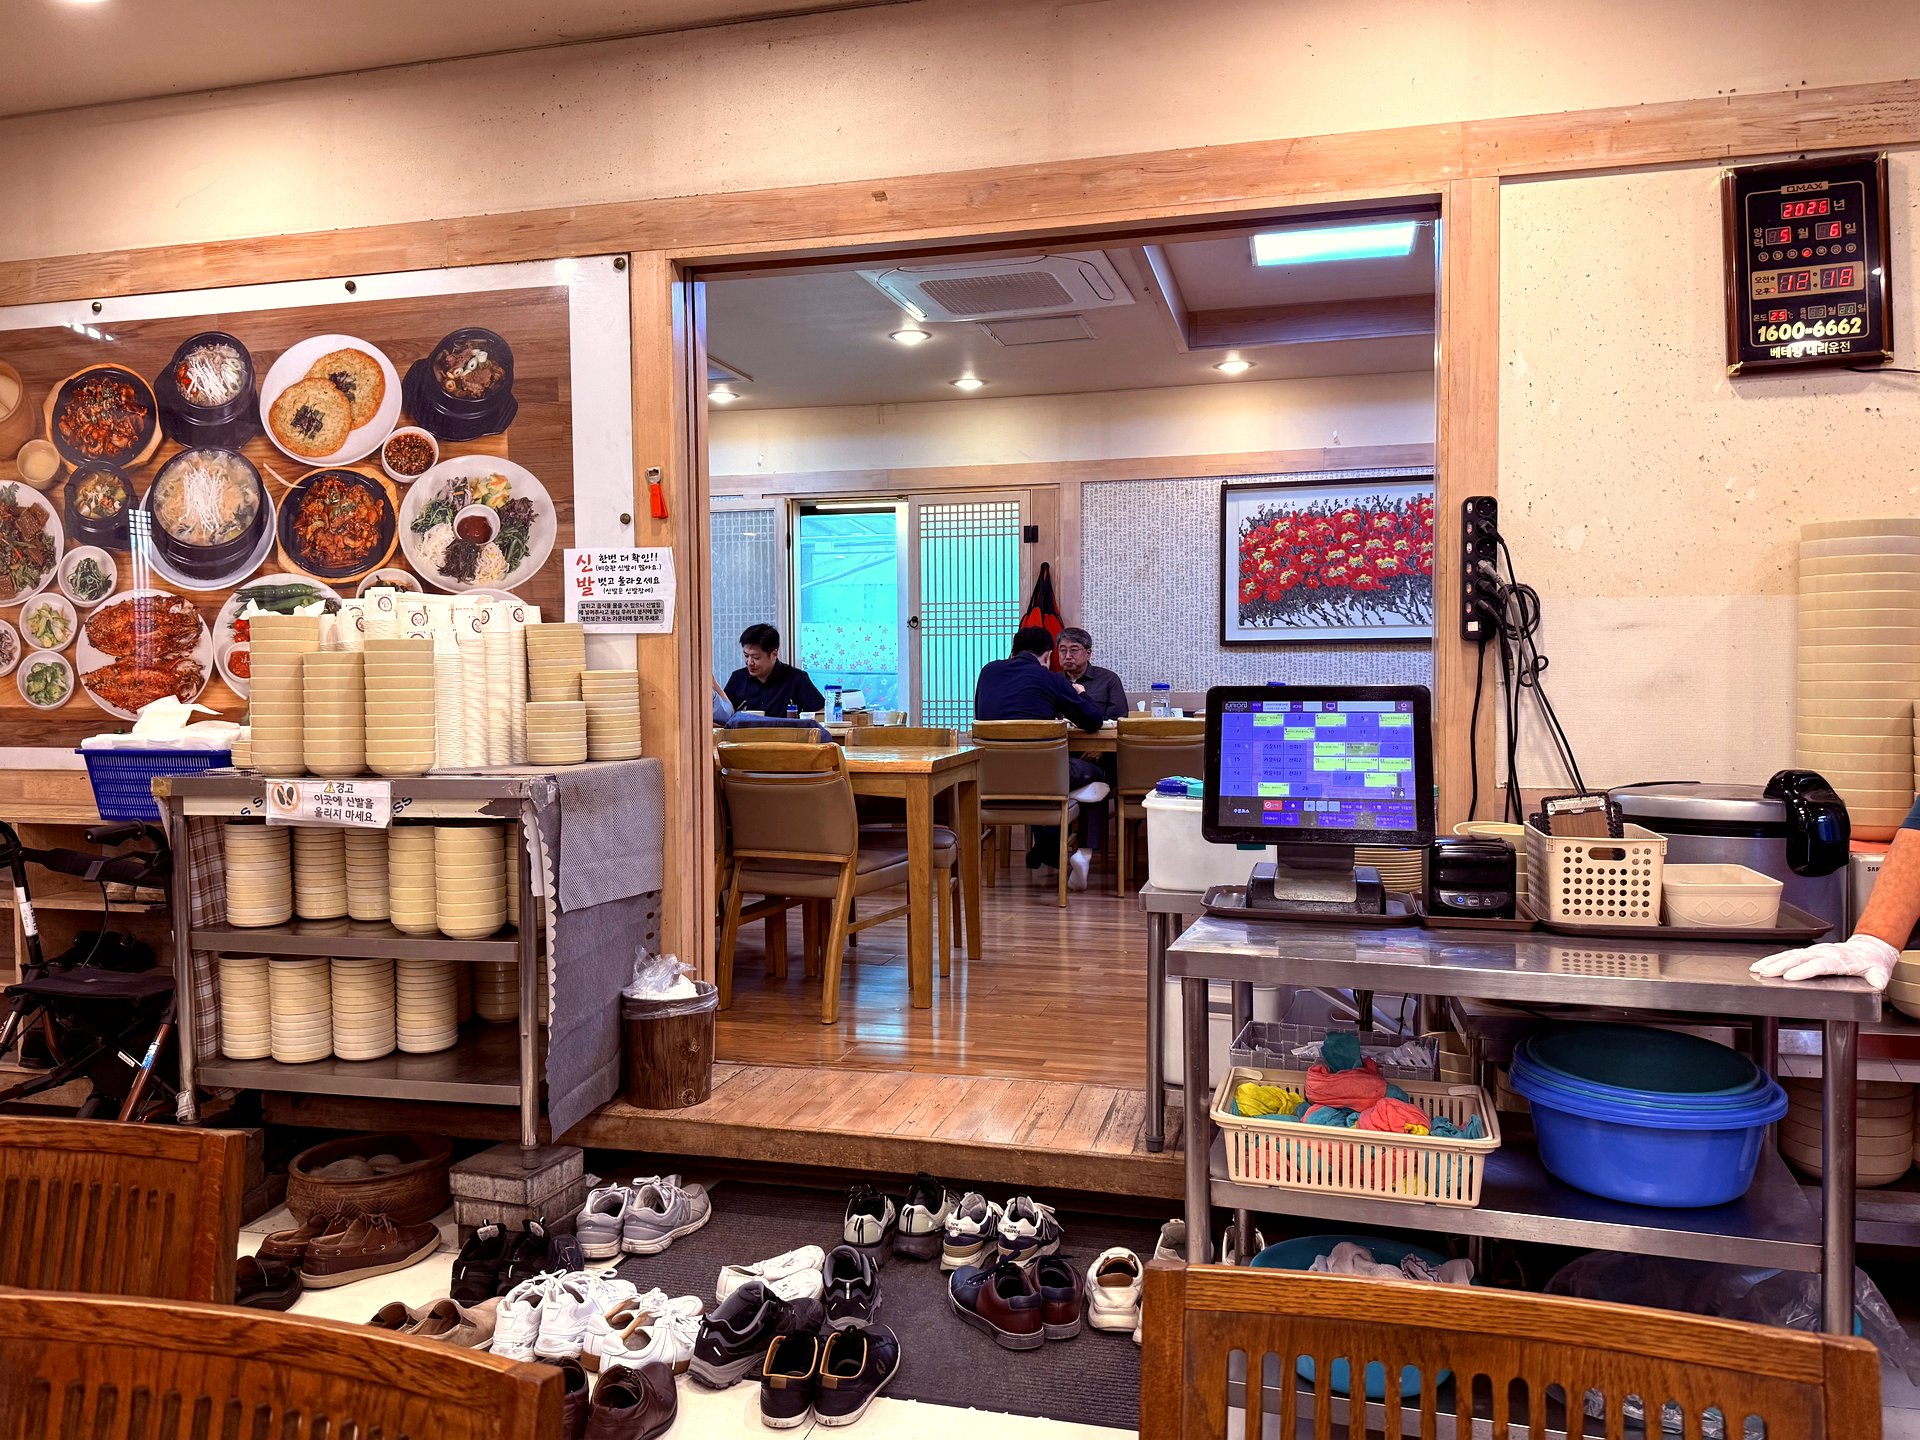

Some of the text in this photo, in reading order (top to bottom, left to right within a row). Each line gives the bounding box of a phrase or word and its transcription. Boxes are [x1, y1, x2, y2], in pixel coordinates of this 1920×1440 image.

[1783, 199, 1845, 218] 2026 년
[1797, 227, 1809, 239] 월
[1845, 223, 1856, 234] 일
[1755, 276, 1770, 284] 오전
[1753, 314, 1768, 322] 온도
[1770, 311, 1785, 321] 25
[1758, 317, 1862, 342] 1600-6662
[576, 554, 593, 572] 신
[598, 554, 617, 564] 한번
[620, 554, 629, 562] 더
[576, 576, 595, 597] 발
[597, 576, 660, 587] 벗고 올라오세요
[337, 782, 354, 794] 경고
[314, 794, 374, 810] 이곳에 신발을
[314, 806, 377, 823] 올리지 마세요.
